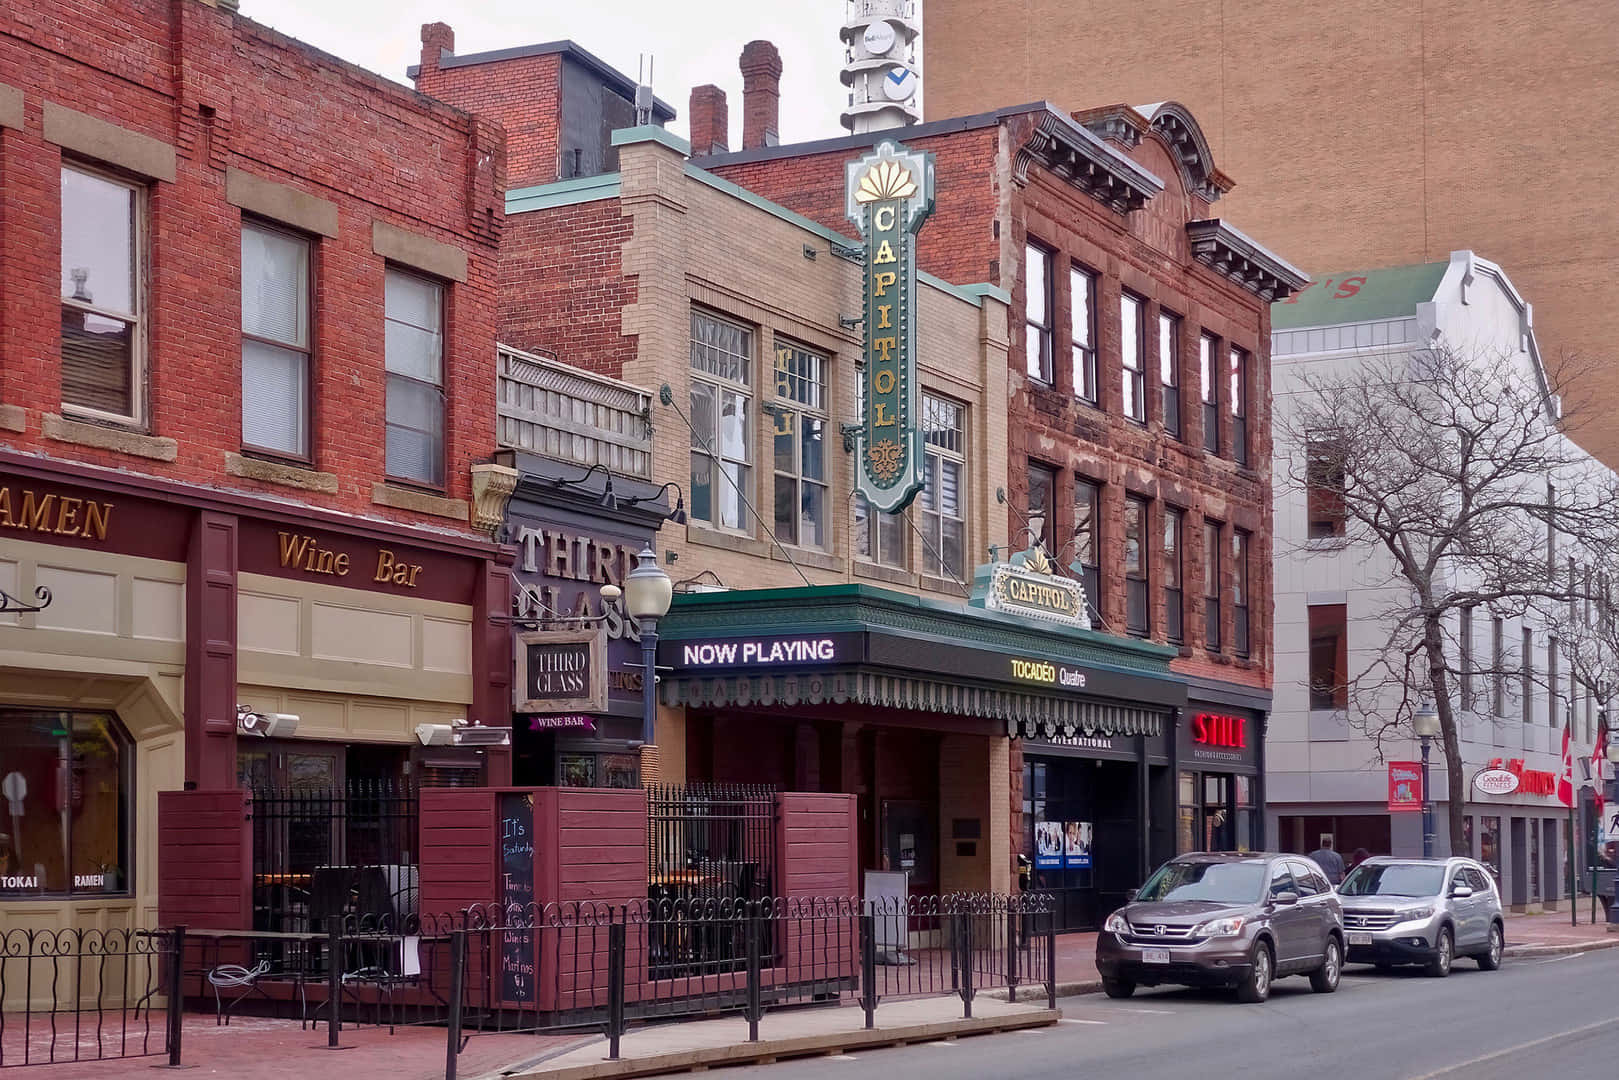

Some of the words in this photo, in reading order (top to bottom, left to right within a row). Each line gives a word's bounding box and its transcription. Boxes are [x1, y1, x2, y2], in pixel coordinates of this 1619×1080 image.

[874, 206, 897, 427] CAPITOL
[278, 531, 350, 576] Wine
[373, 549, 423, 587] Bar
[1010, 579, 1070, 611] CAPITOL
[537, 652, 586, 673] THIRD
[684, 643, 738, 665] NOW
[743, 639, 835, 663] PLAYING
[537, 673, 585, 693] GLASS
[538, 718, 563, 727] WINE
[565, 716, 585, 726] BAR
[1194, 713, 1248, 748] STILE
[0, 876, 38, 888] TOKAI
[74, 875, 104, 887] RAMEN
